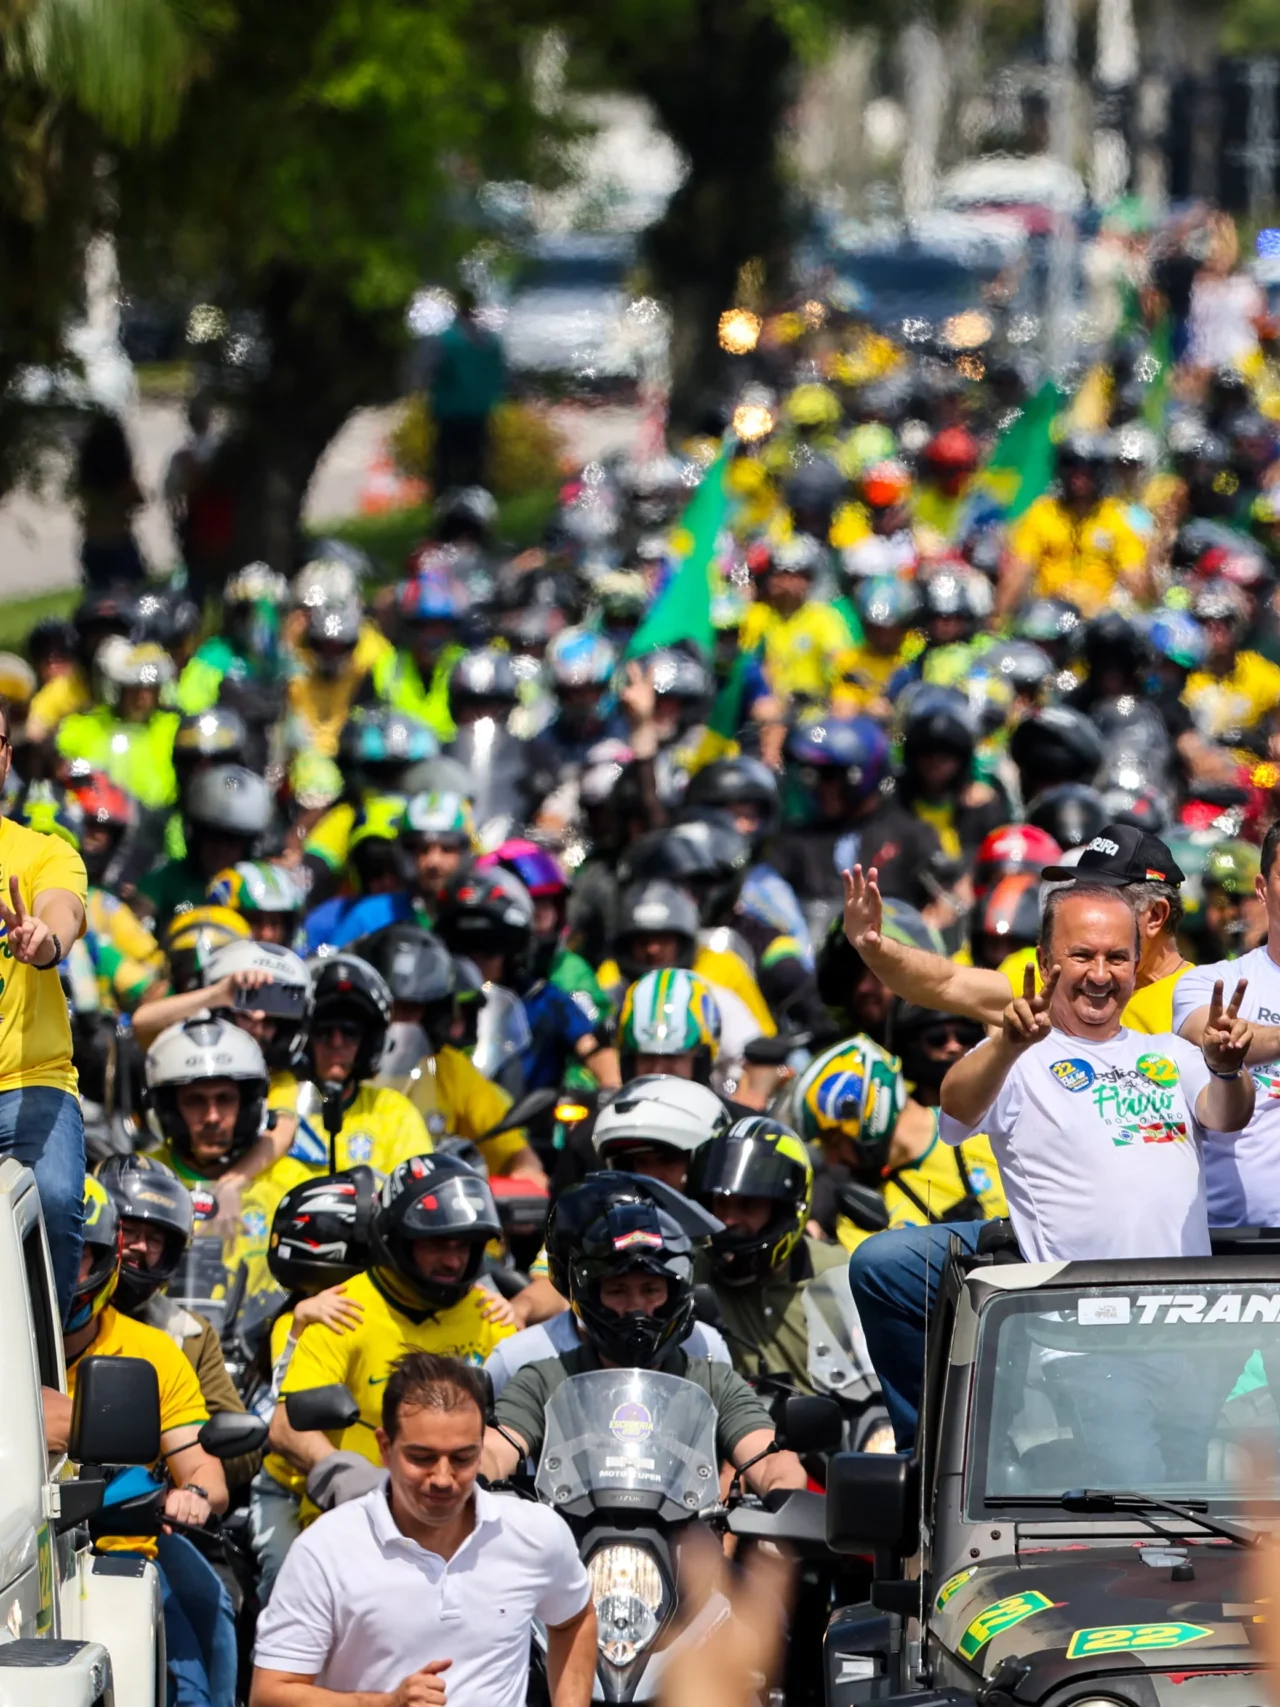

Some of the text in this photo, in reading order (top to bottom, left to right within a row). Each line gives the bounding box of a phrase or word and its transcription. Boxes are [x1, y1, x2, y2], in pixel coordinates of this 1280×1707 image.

[1052, 1062, 1077, 1078] 22
[1138, 1058, 1179, 1080] 22
[1105, 1112, 1183, 1126] BOLONARO
[1083, 1626, 1183, 1650] 22
